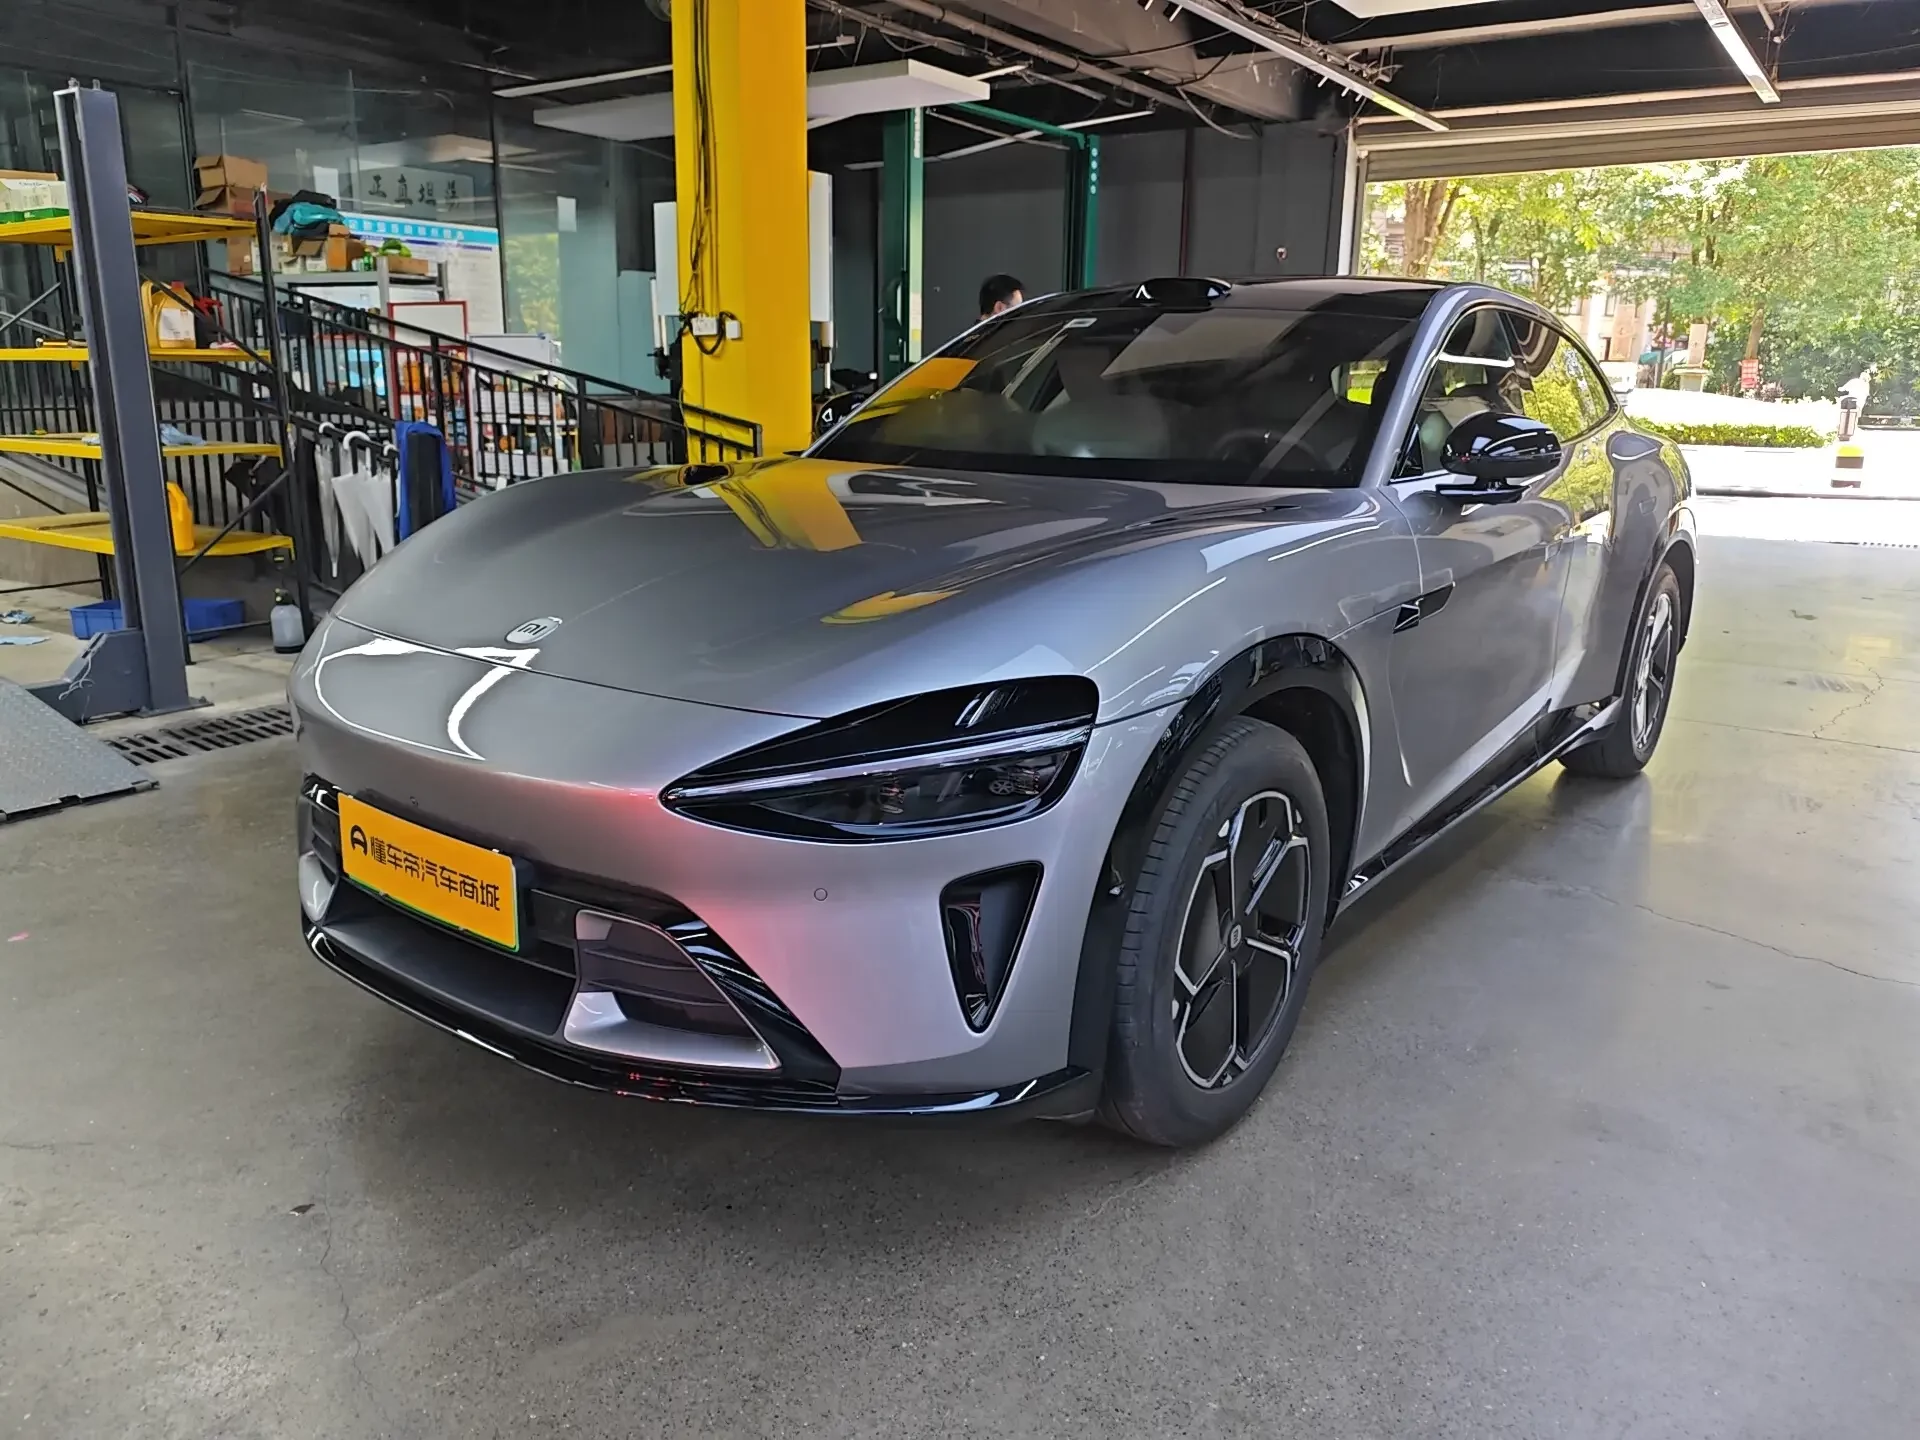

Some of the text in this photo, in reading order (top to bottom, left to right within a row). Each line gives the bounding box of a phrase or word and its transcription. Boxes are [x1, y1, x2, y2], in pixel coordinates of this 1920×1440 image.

[370, 836, 500, 911] 懂车帝汽车商城
